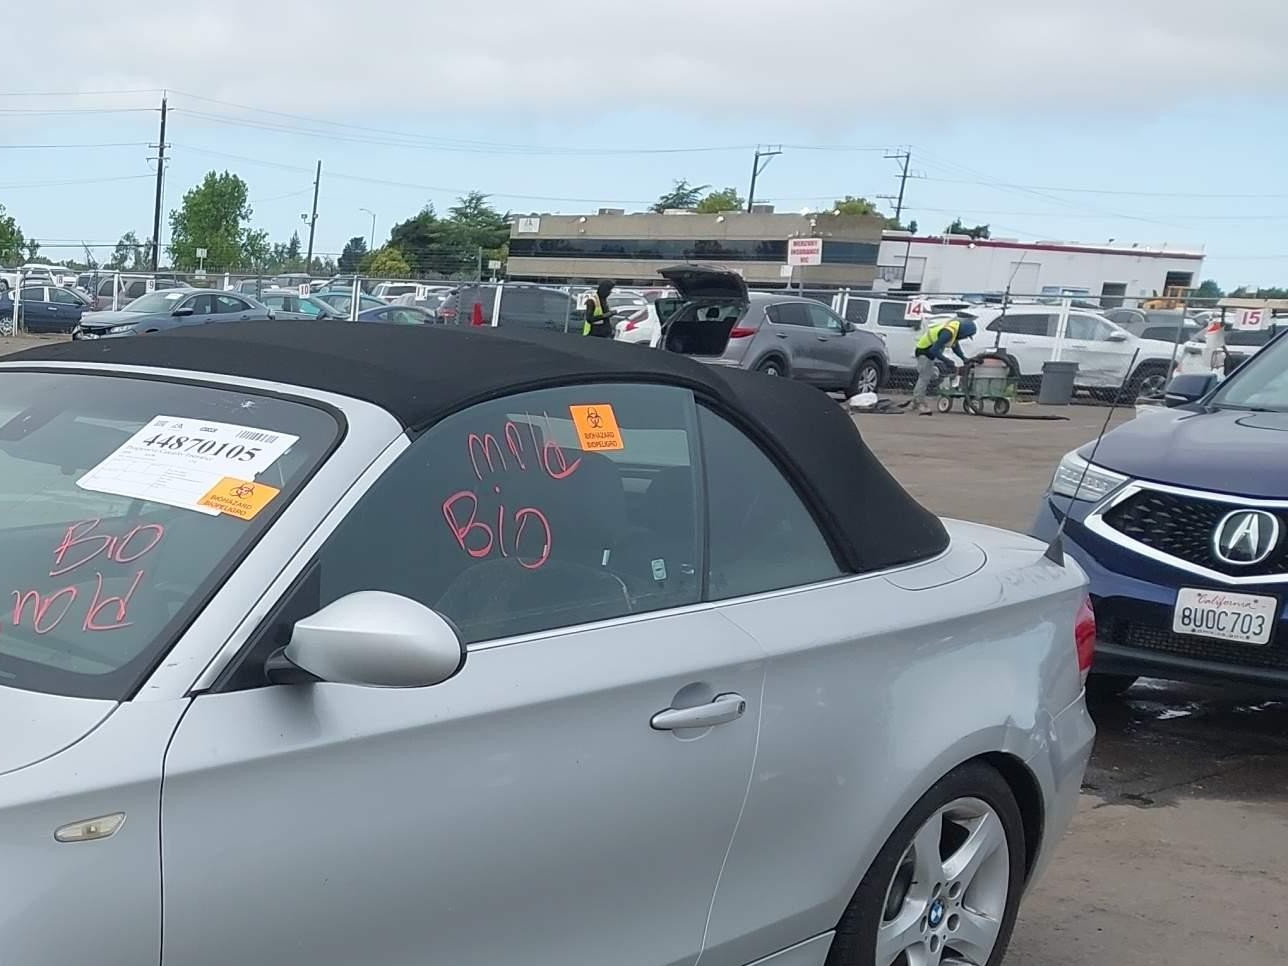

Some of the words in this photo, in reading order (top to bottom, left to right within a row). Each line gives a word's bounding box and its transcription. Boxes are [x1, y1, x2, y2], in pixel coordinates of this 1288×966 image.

[907, 303, 921, 315] 14
[1242, 311, 1261, 325] 15
[143, 433, 263, 462] 44870105
[1197, 593, 1256, 609] California
